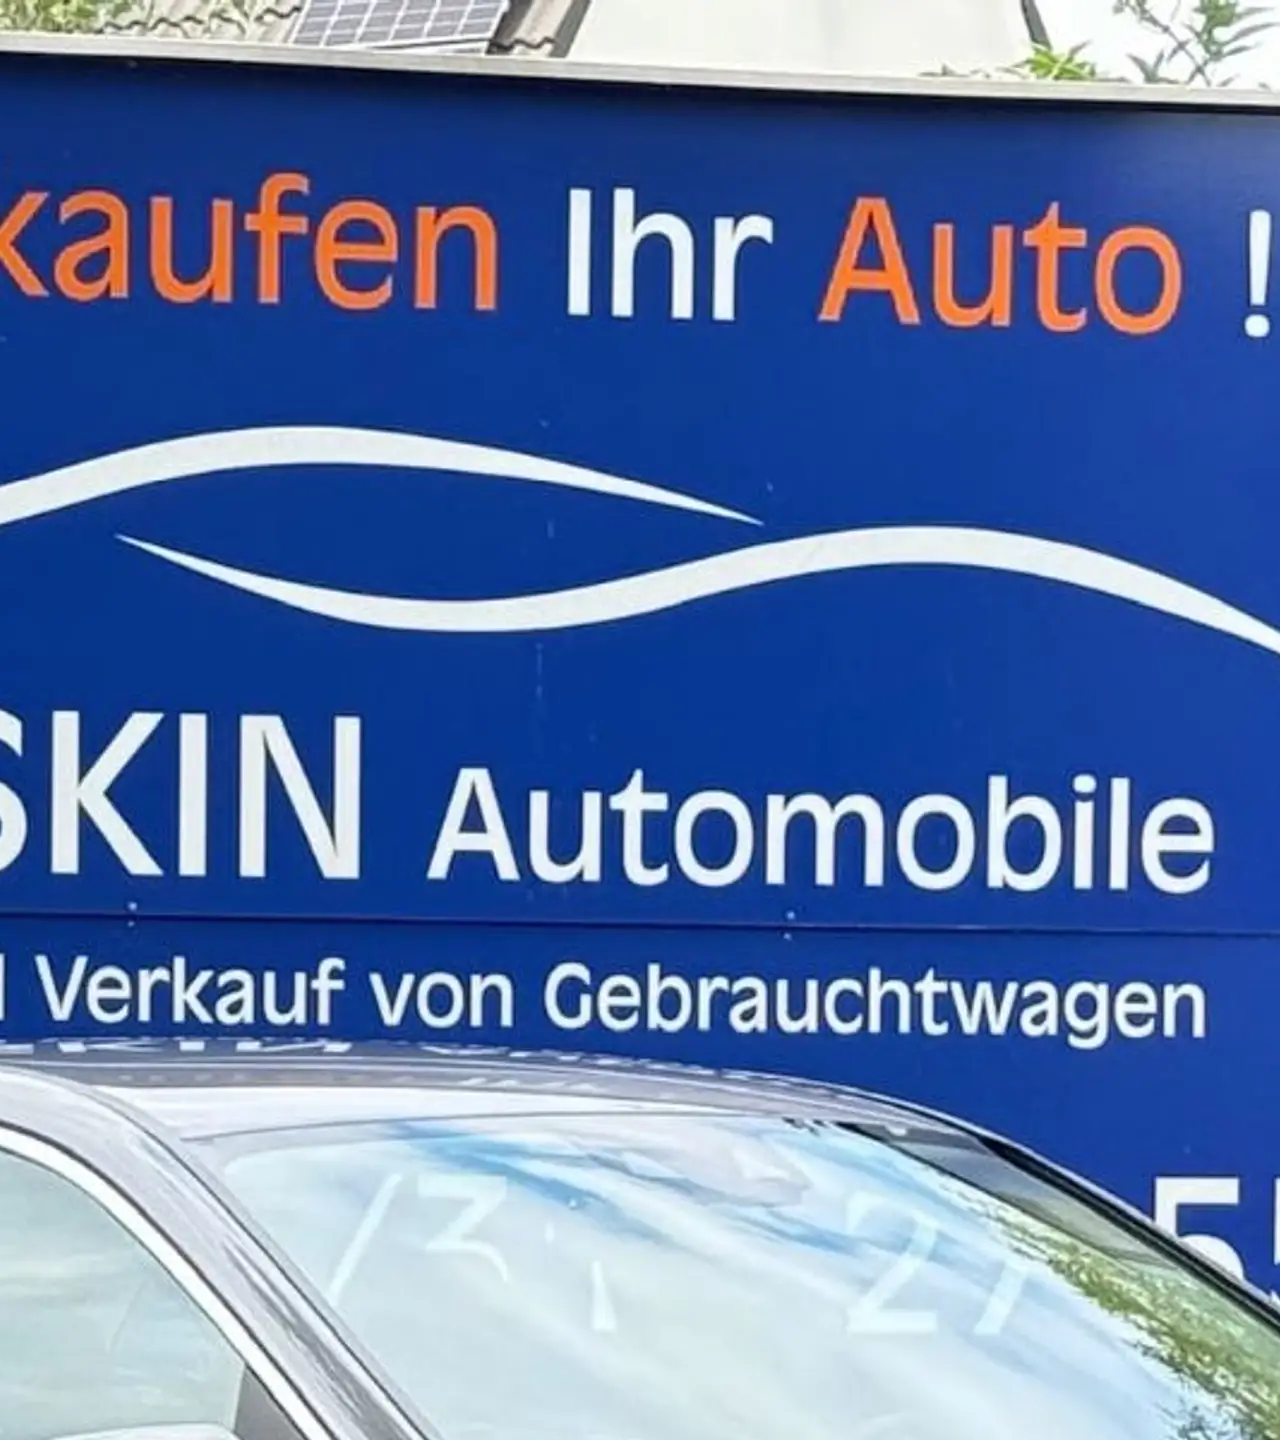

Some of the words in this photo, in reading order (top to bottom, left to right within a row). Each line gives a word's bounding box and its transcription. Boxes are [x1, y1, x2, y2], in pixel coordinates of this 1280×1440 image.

[567, 187, 773, 321] Ihr
[818, 196, 1183, 335] Auto
[1244, 209, 1272, 338] !
[427, 767, 1214, 894] Automobile
[35, 955, 345, 1026] Verkauf
[369, 973, 513, 1028] von
[544, 962, 1205, 1049] Gebrauchtwagen
